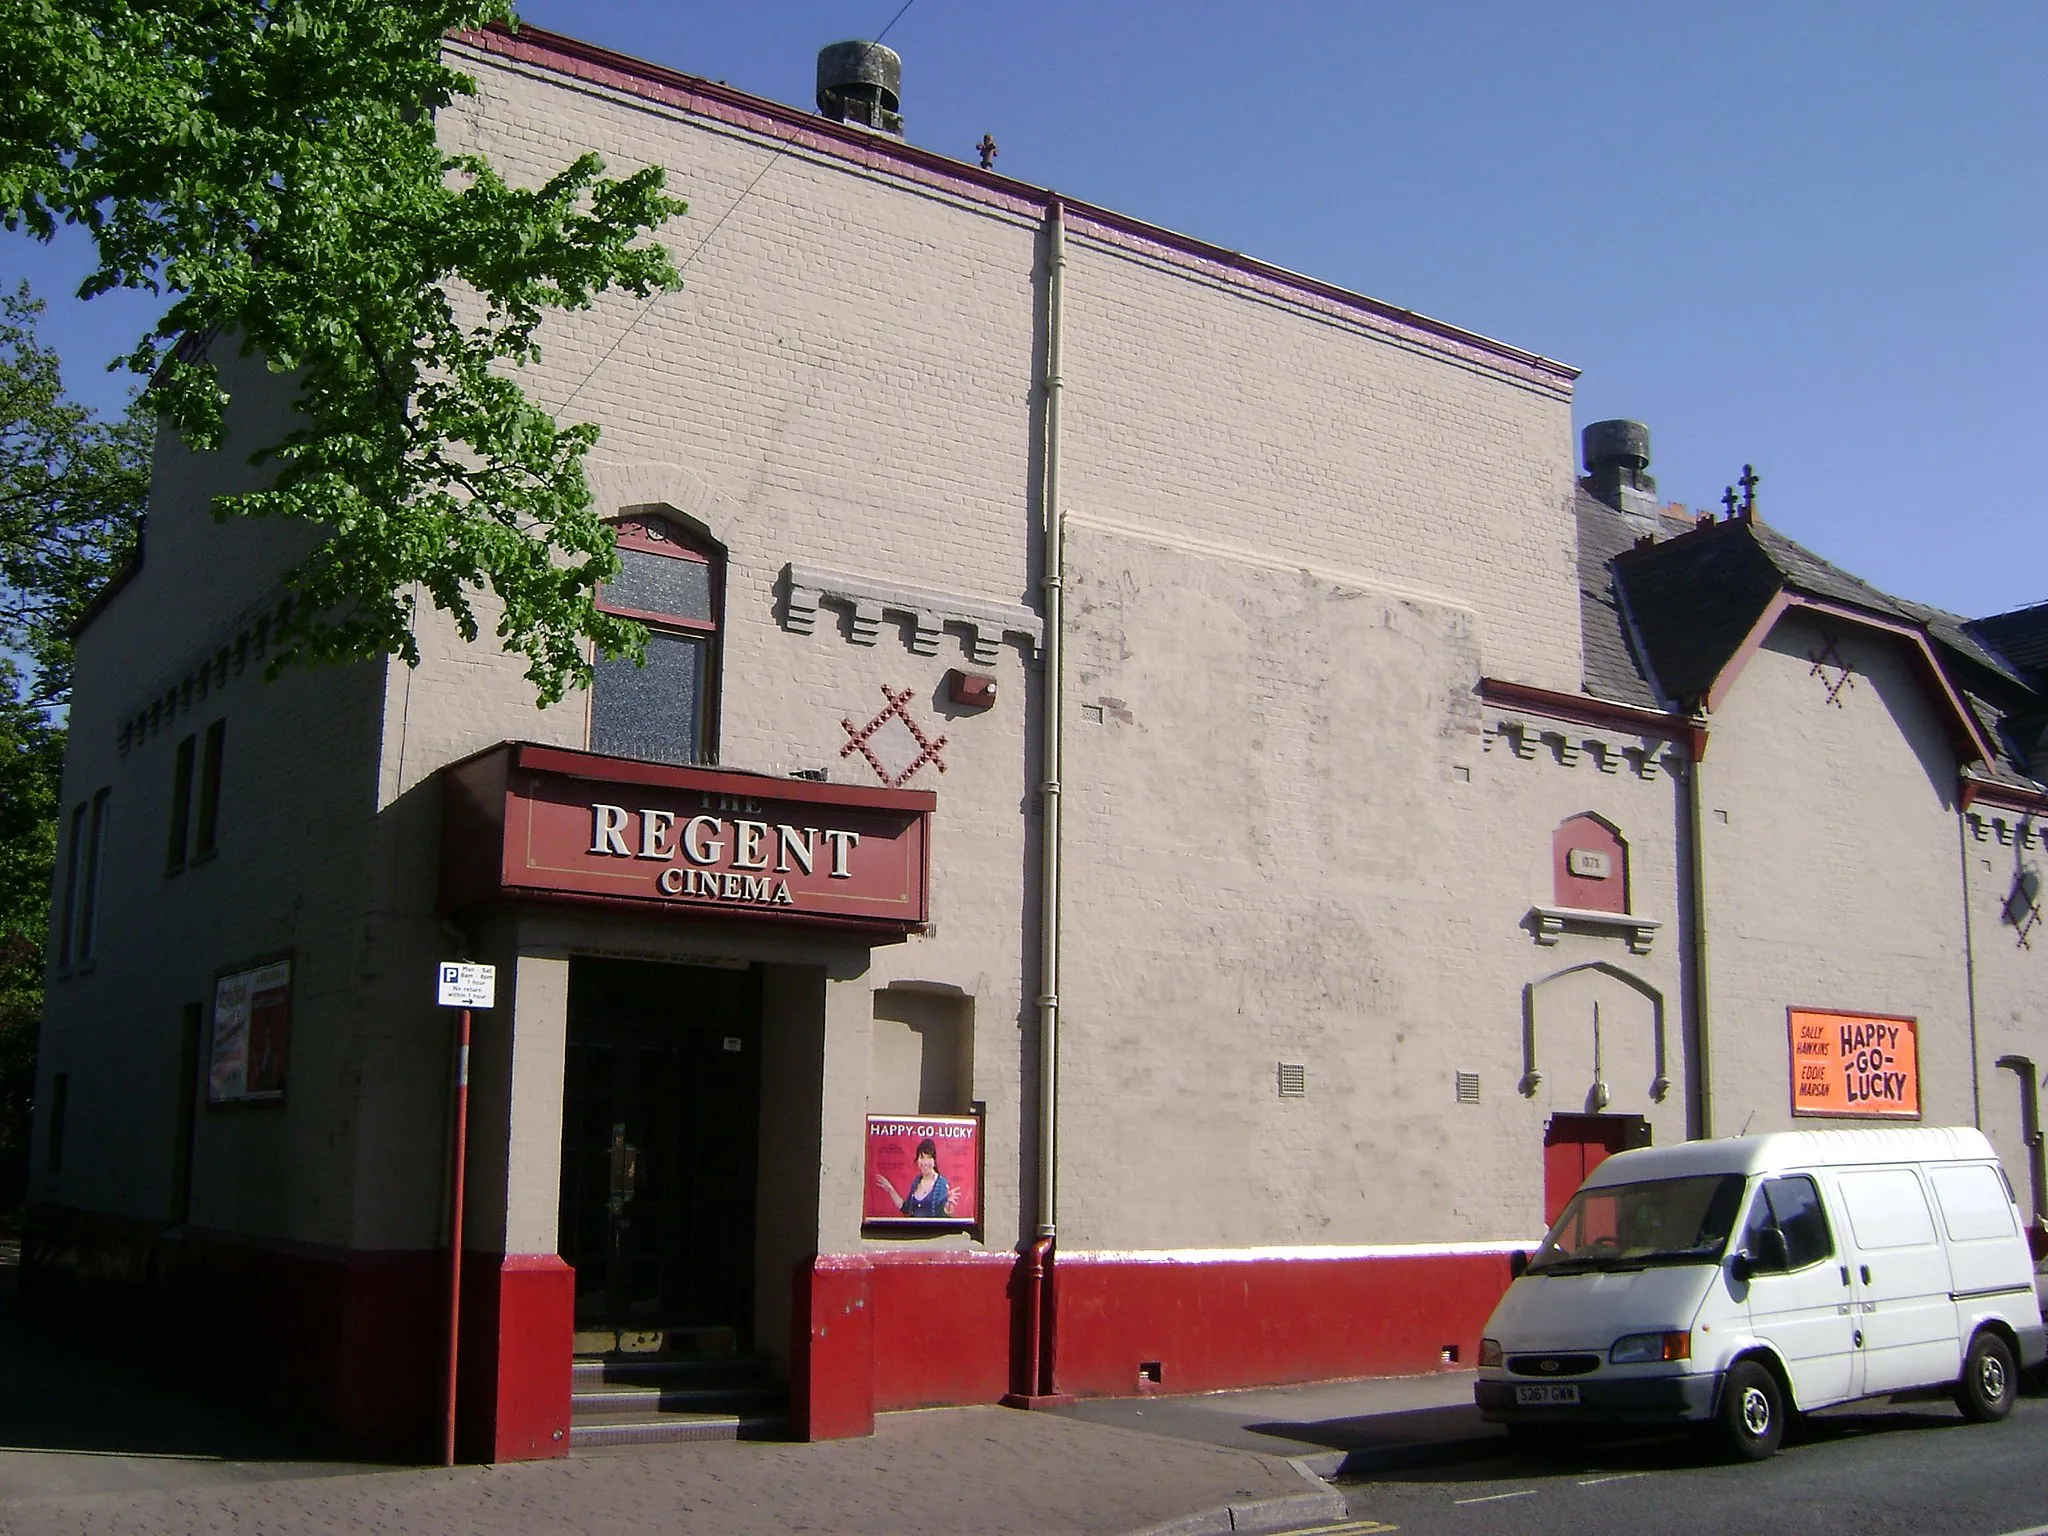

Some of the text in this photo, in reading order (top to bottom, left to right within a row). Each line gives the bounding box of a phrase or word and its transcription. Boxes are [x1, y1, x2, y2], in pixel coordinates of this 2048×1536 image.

[589, 803, 860, 877] REGENT
[660, 867, 794, 904] CINEMA
[1801, 1025, 1824, 1039] SALLY
[1840, 1023, 1899, 1057] HAPPY
[1796, 1042, 1830, 1056] HAWKINS
[1801, 1066, 1826, 1080] EDDIE
[1846, 1072, 1907, 1102] LUCKY
[870, 1124, 973, 1138] HAPPY-GO-LUCKY
